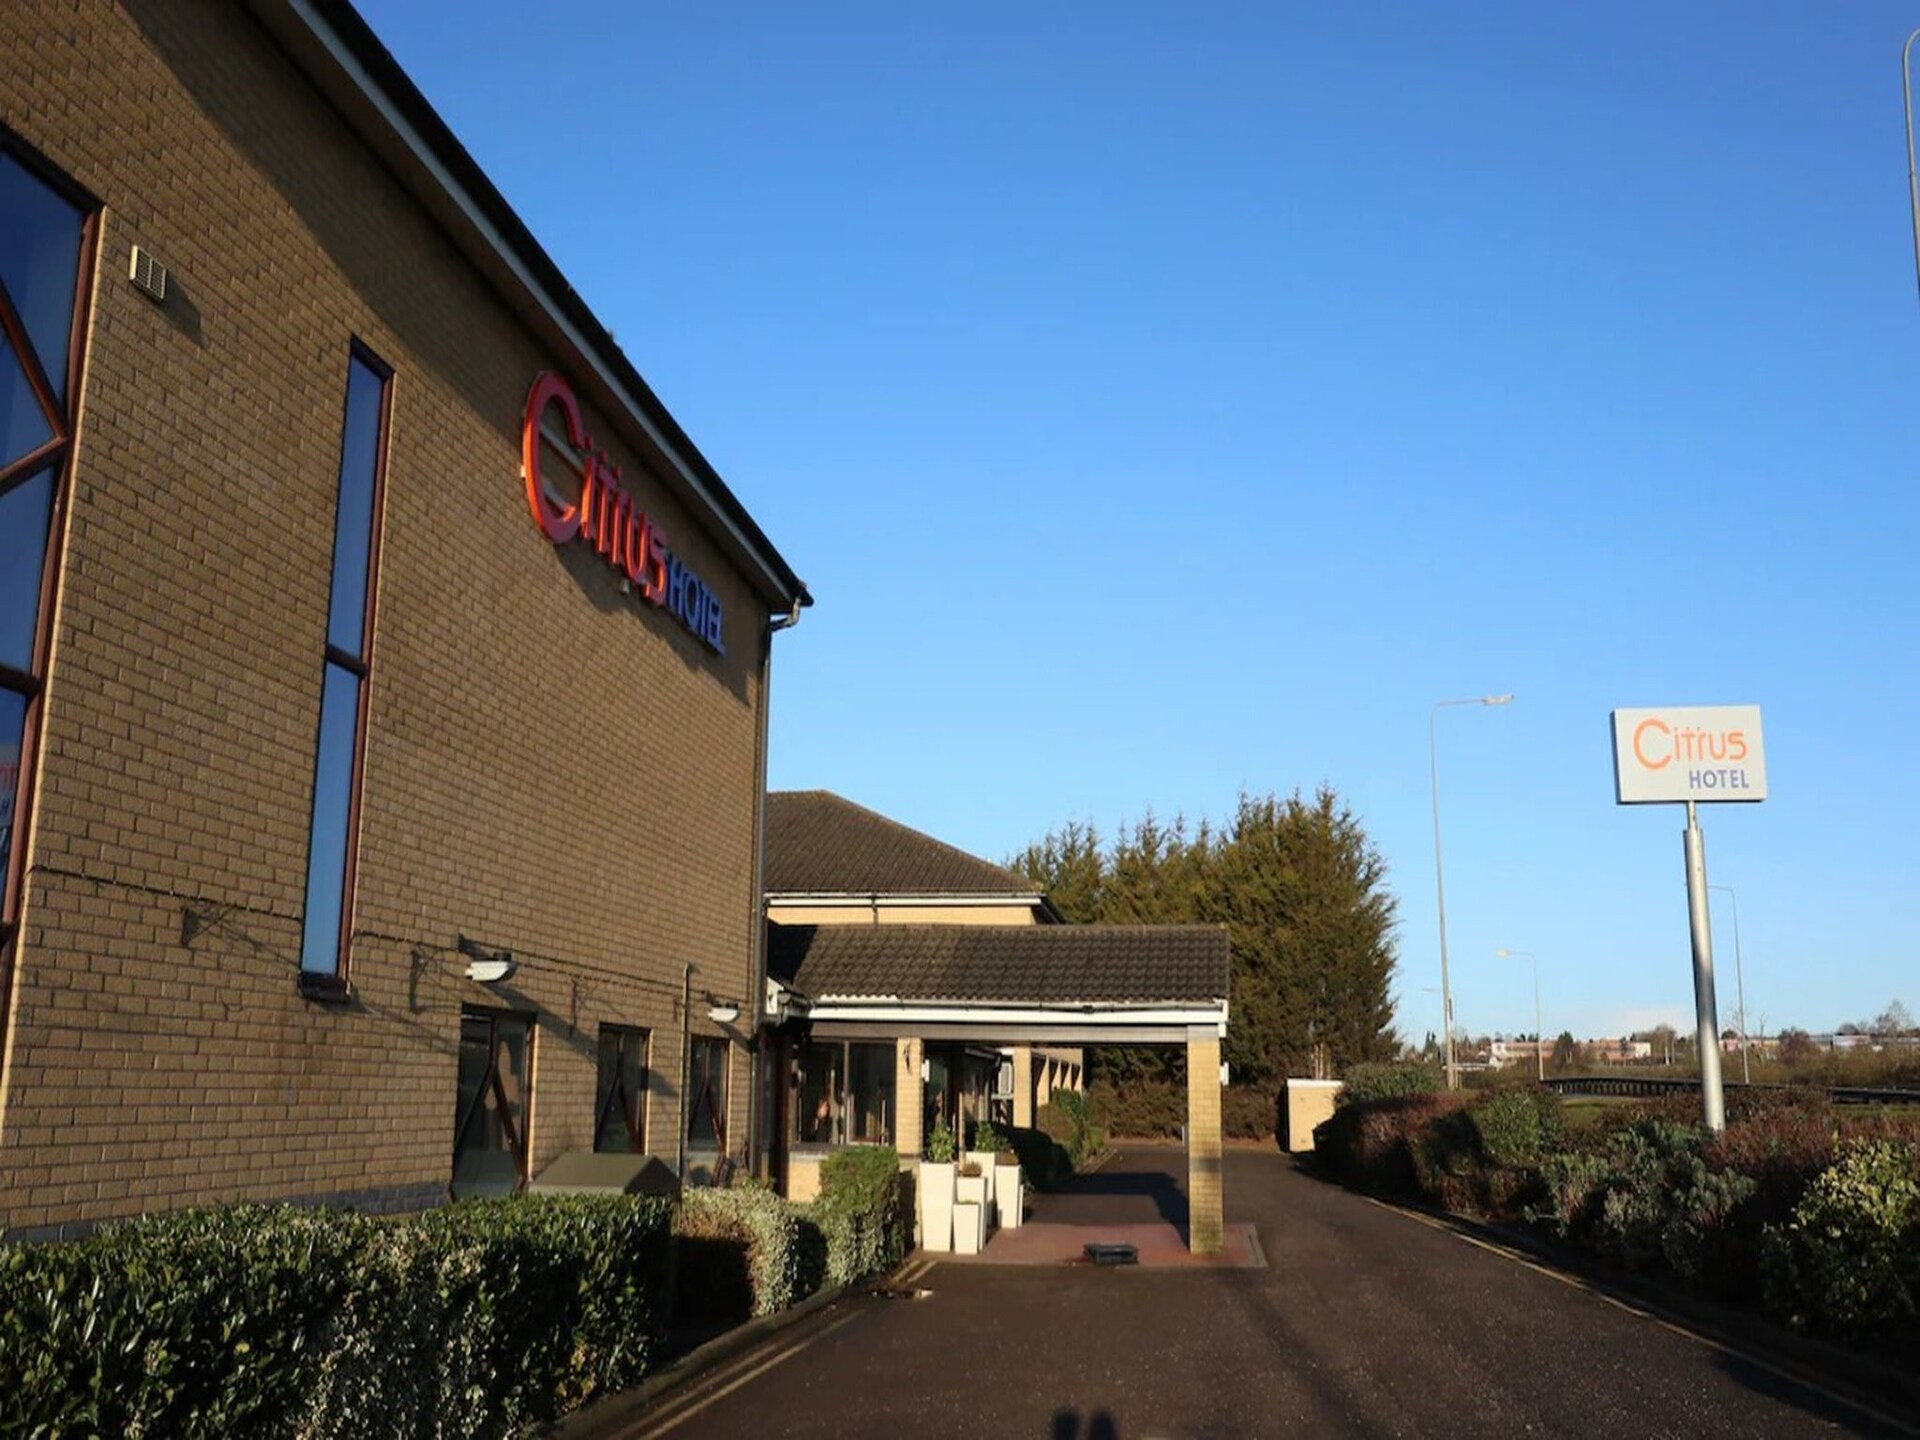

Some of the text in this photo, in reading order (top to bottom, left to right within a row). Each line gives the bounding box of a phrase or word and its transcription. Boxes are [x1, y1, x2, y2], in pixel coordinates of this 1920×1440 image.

[522, 370, 725, 655] Citrus HOTEL
[1633, 718, 1747, 770] Citrus
[1689, 769, 1749, 789] HOTEL
